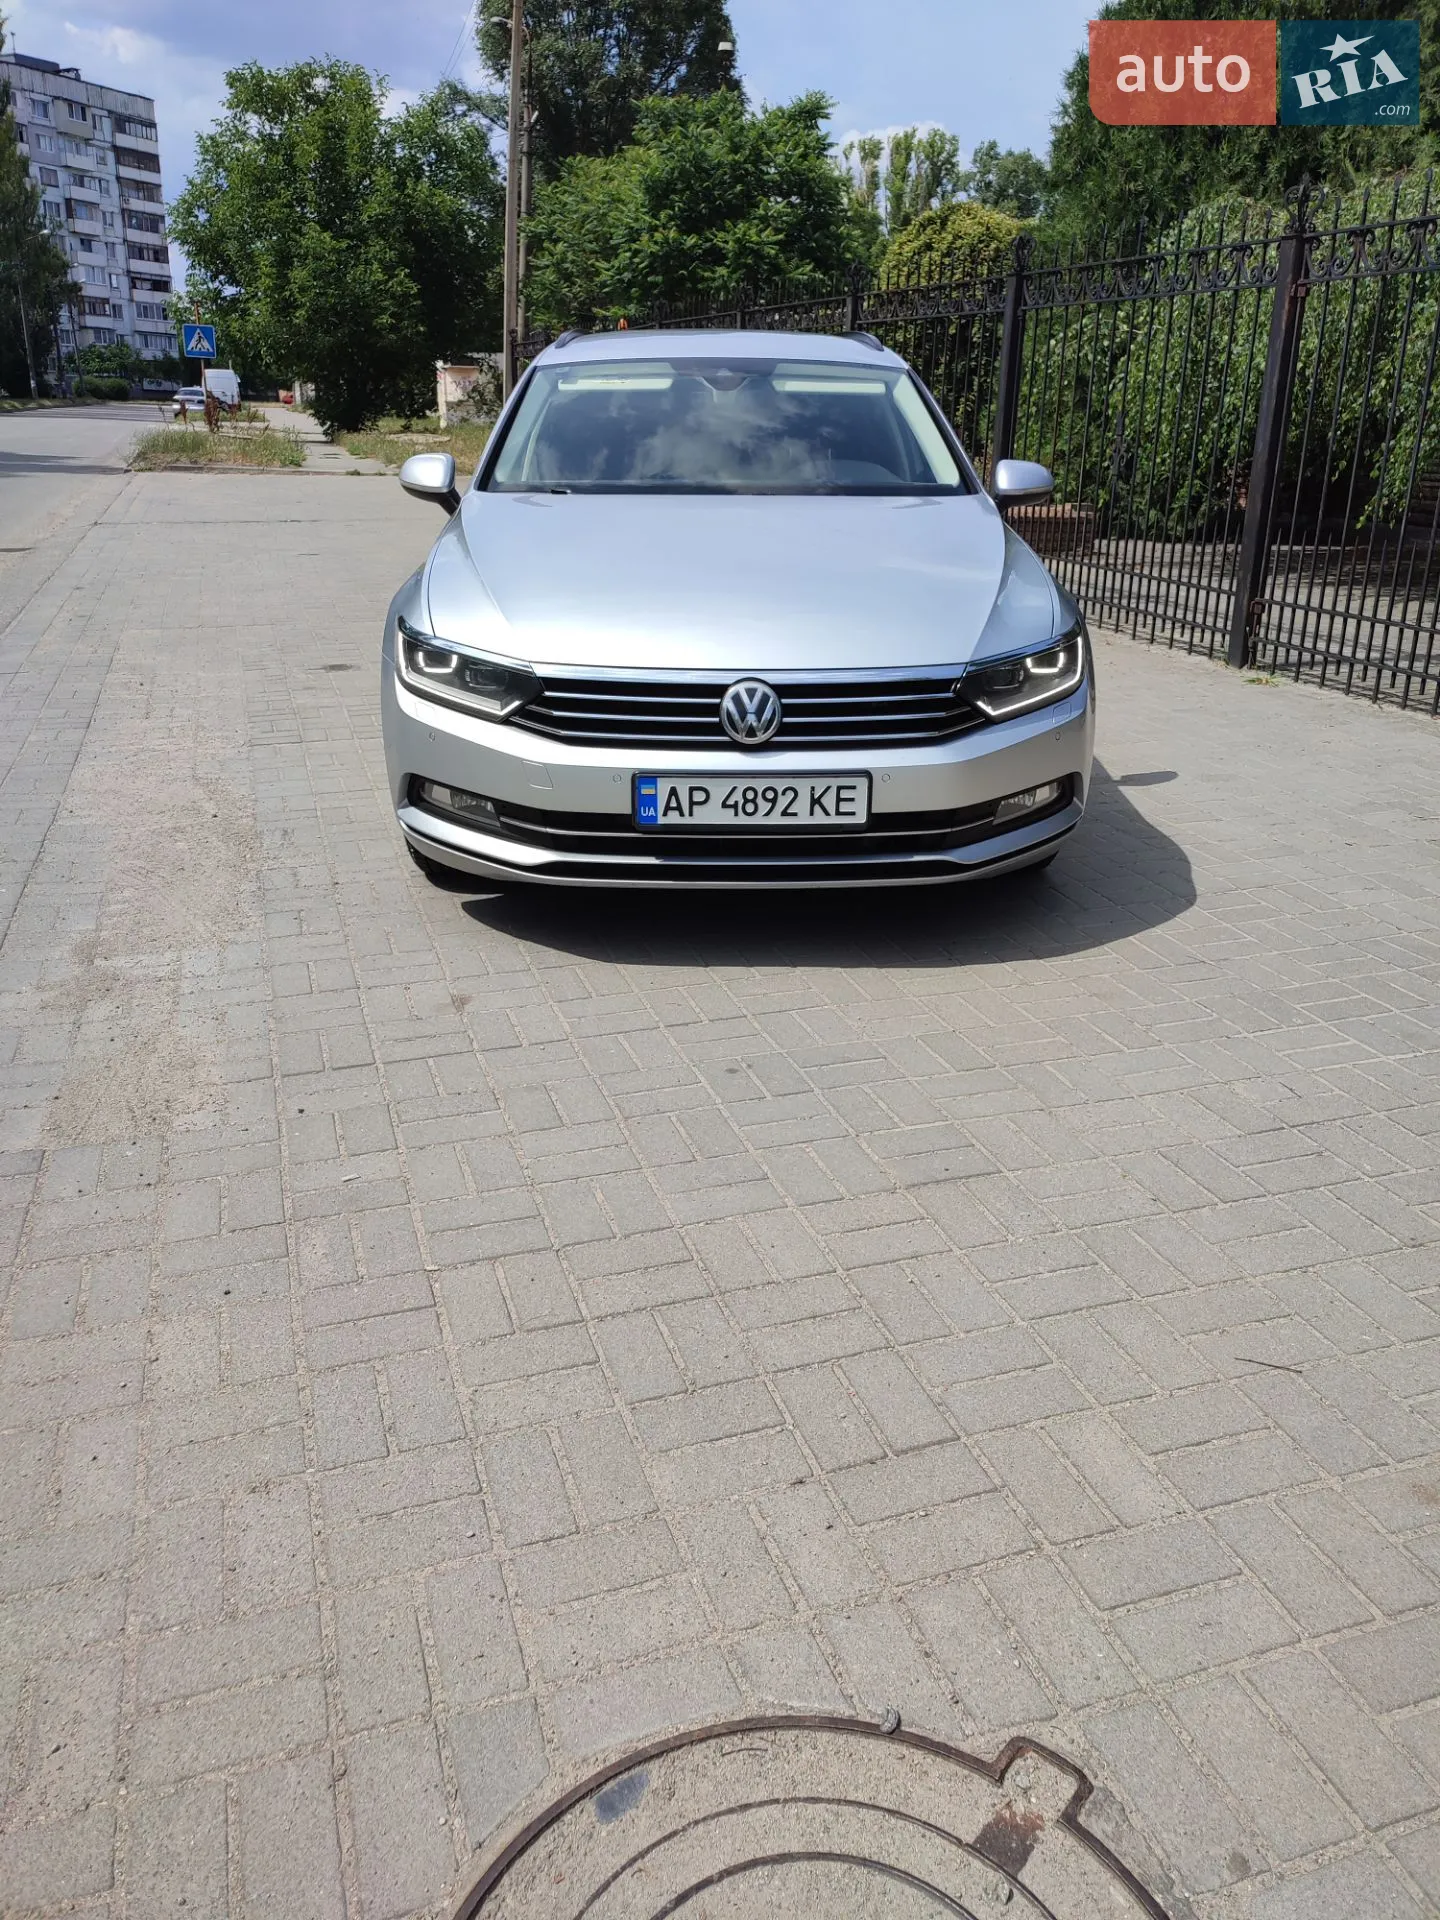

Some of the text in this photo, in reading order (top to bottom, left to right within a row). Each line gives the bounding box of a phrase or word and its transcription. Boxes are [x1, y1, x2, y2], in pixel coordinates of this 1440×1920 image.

[640, 806, 656, 817] UA
[661, 785, 857, 817] AP 4892 KE
